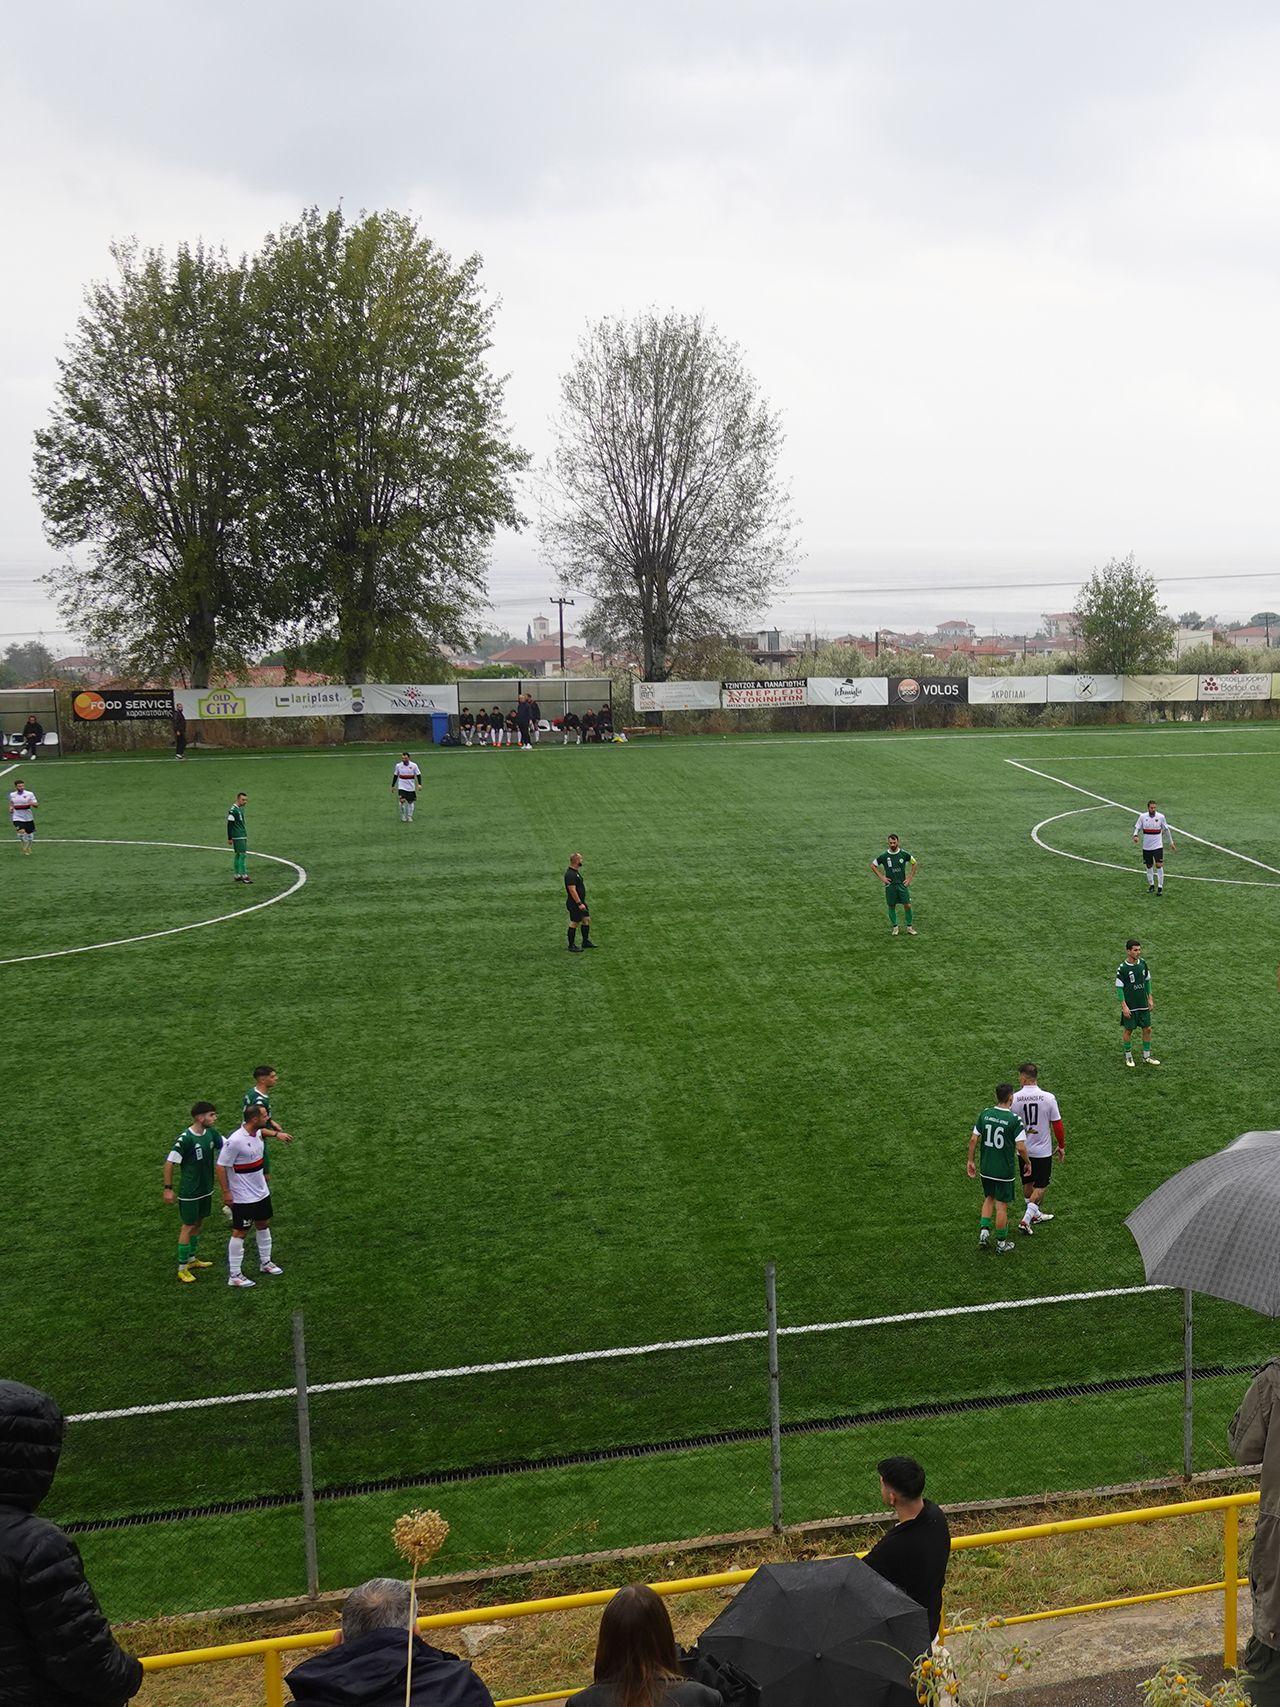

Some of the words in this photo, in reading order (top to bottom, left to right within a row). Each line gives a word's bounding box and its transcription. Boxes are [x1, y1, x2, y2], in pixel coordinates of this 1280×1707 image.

[764, 680, 805, 688] ΠΑΝΑΓΙΩΤΗΣ
[727, 689, 803, 697] ΣΥΝΕΡΓΕΙΟ
[922, 685, 959, 695] VOLOS
[291, 693, 339, 704] lariplast
[728, 695, 803, 703] ΑΥΤΟΚΙΝΗΤΩΝ
[90, 701, 122, 710] FOOD
[126, 700, 172, 709] SERVICE
[1023, 1103, 1039, 1126] 10
[984, 1124, 1005, 1149] 16
